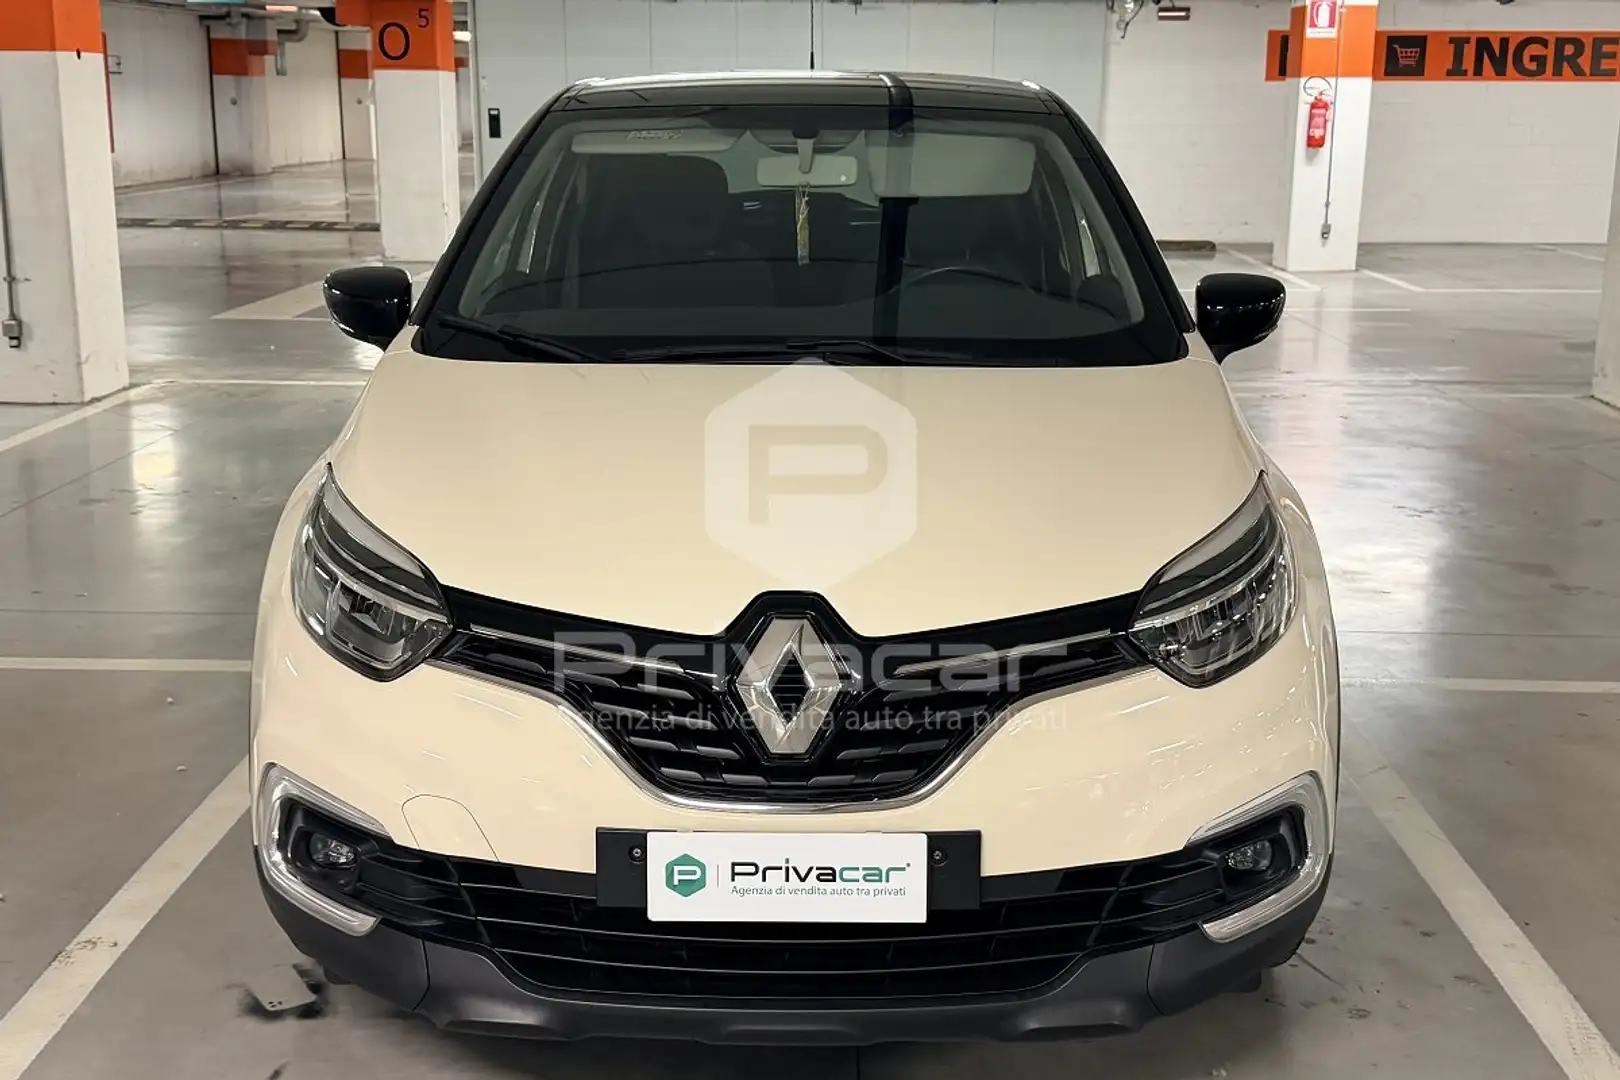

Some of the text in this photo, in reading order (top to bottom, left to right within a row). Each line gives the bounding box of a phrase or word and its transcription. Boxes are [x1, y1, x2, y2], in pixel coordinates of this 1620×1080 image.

[416, 8, 430, 29] 5
[731, 858, 907, 883] Privacar
[731, 885, 906, 897] Agenzia di vendita auto tra privati
